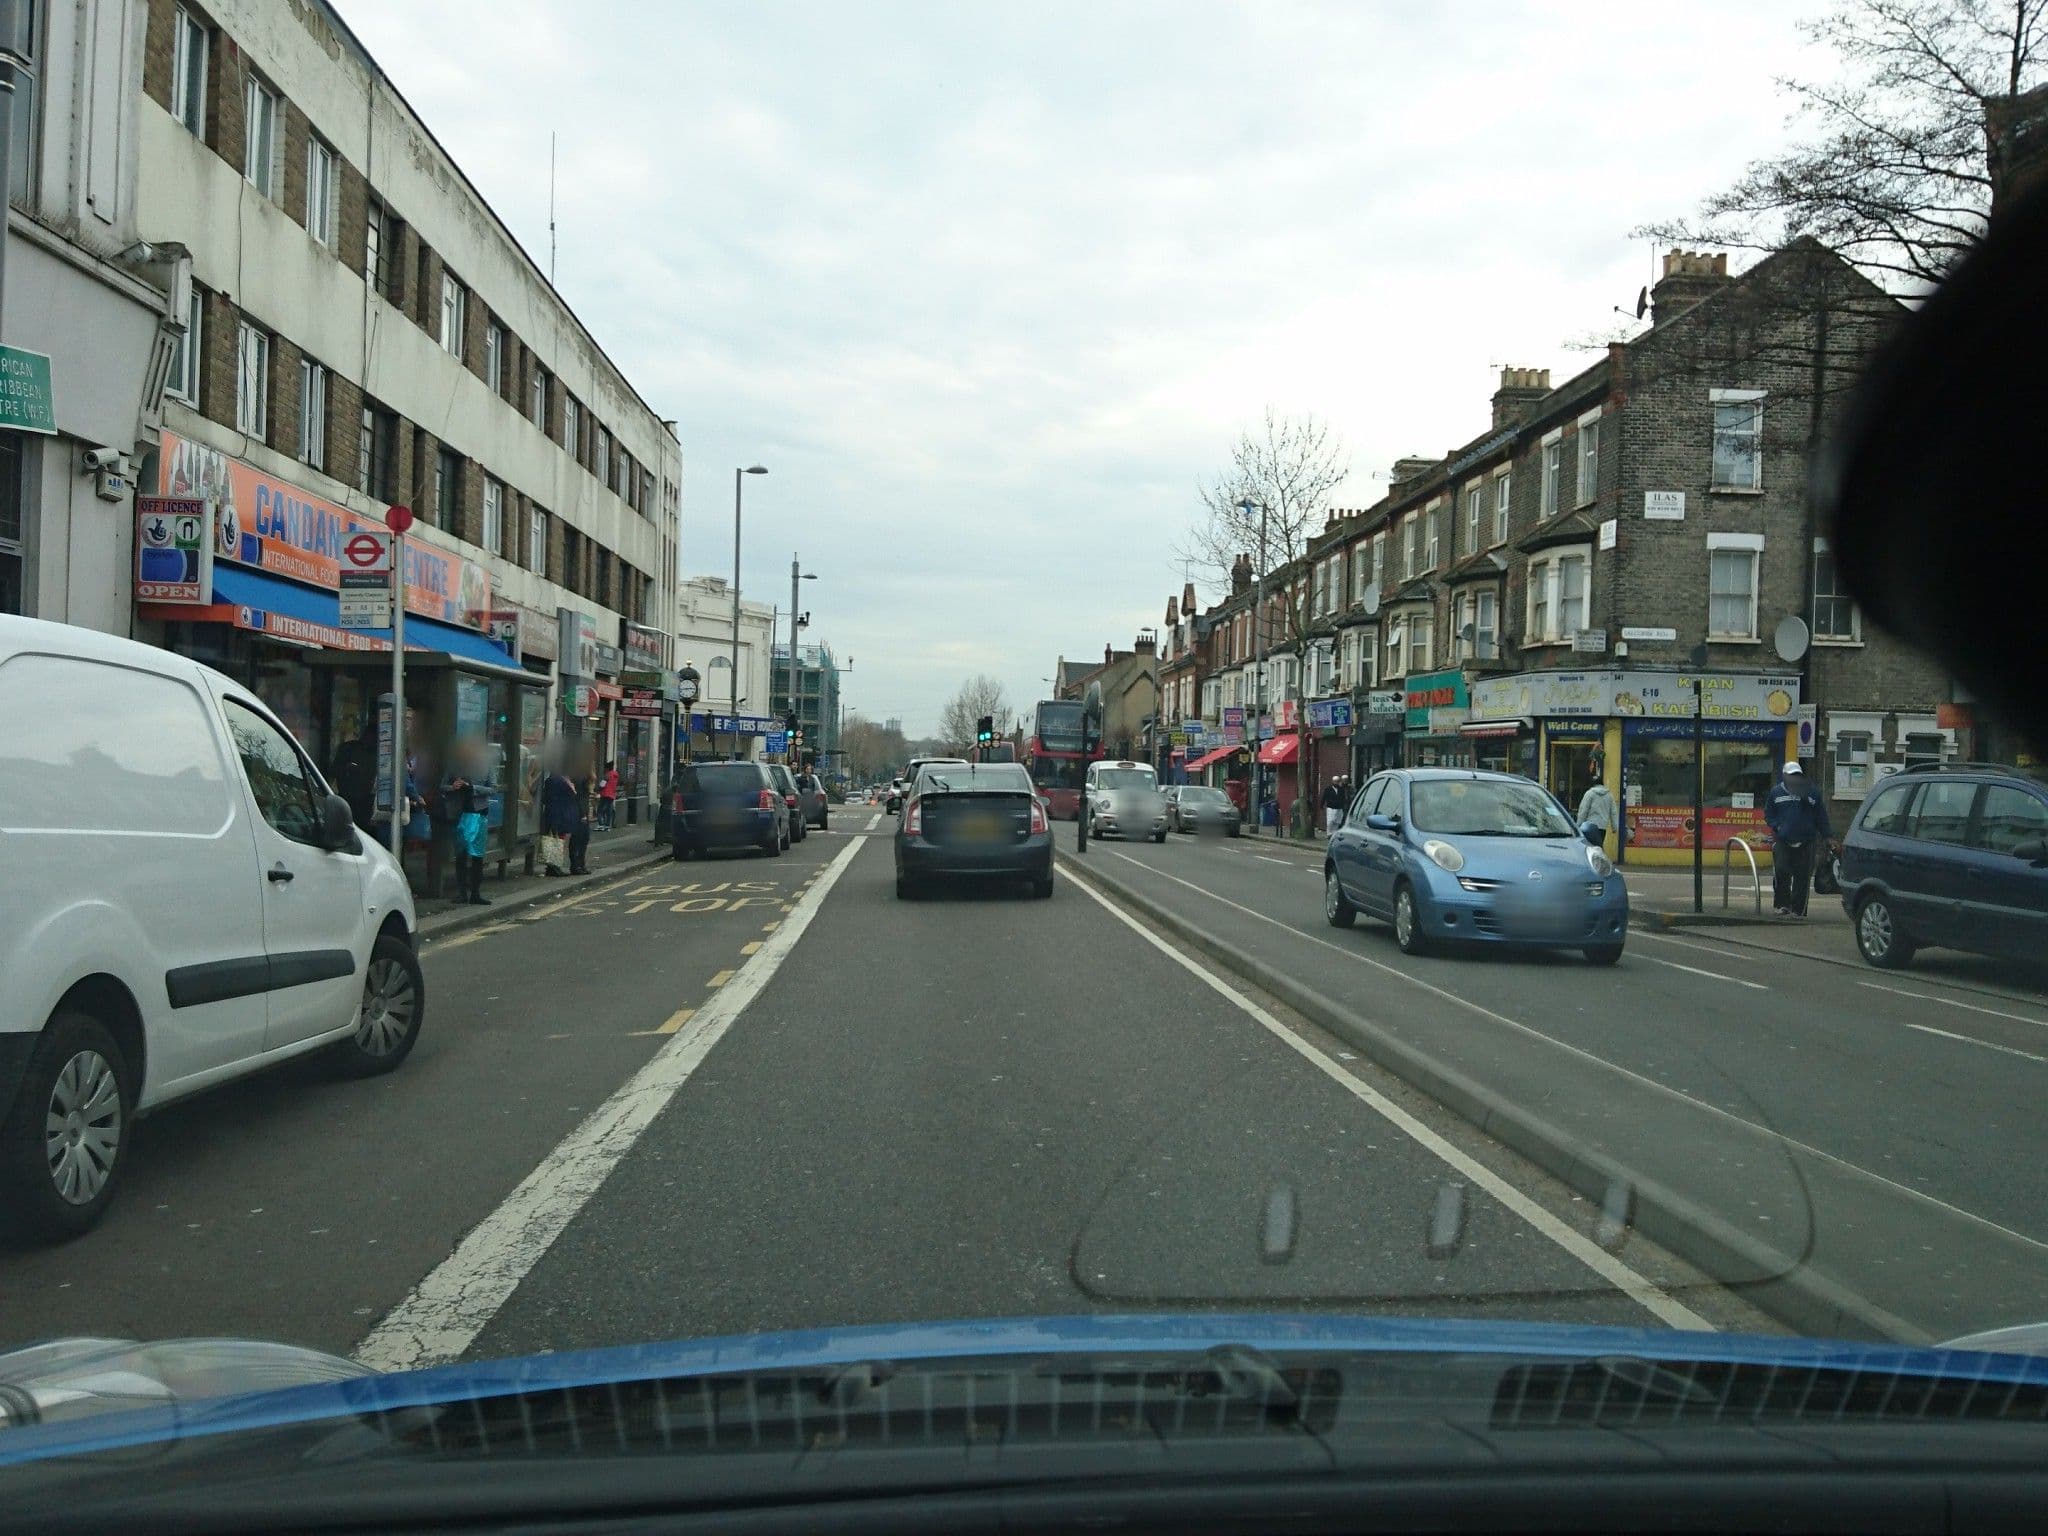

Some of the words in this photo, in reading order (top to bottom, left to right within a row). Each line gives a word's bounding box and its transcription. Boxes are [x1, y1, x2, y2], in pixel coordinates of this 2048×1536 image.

[140, 500, 159, 512] OFF
[162, 501, 204, 514] LICENCE
[255, 484, 341, 560] CANDAN
[262, 548, 319, 580] INTERNATIONAL
[138, 585, 200, 598] OPEN
[271, 615, 347, 647] INTERNATIONAL
[347, 636, 371, 651] FOOD
[1547, 721, 1568, 731] Well
[1570, 721, 1598, 731] Come
[624, 881, 779, 896] BUS
[553, 897, 785, 917] STOP
